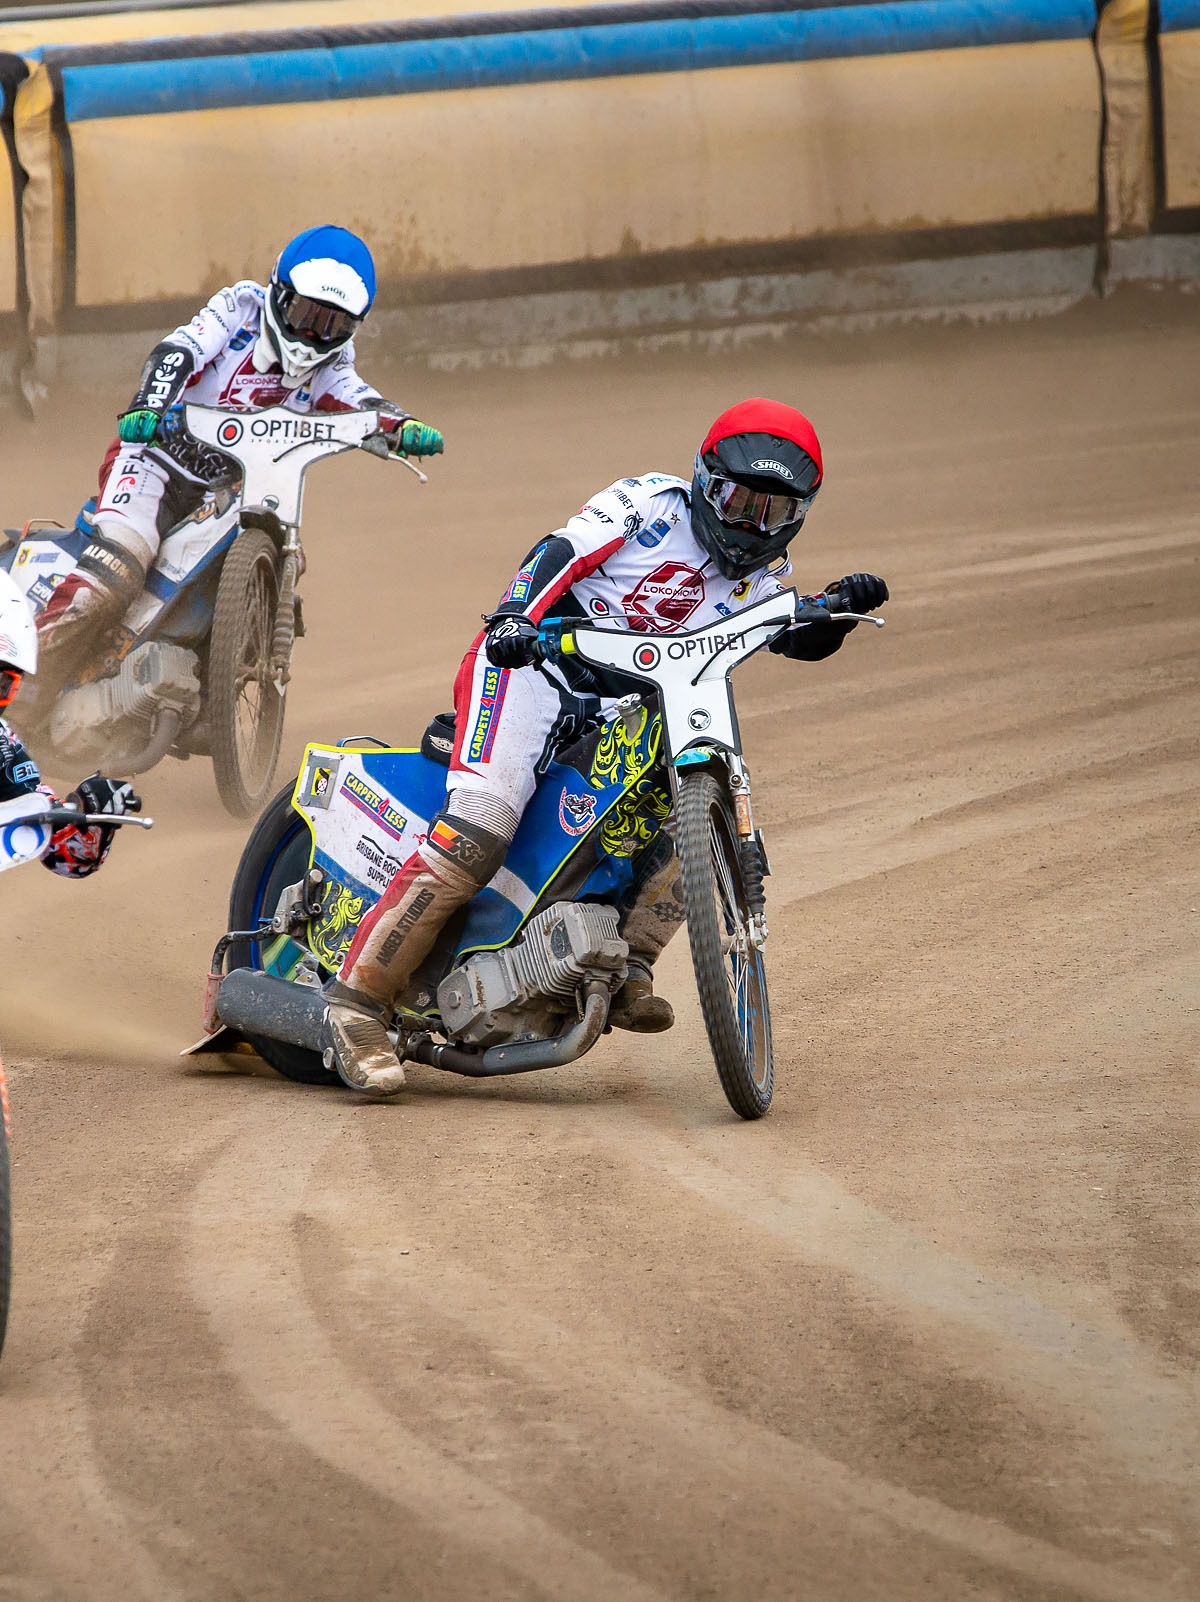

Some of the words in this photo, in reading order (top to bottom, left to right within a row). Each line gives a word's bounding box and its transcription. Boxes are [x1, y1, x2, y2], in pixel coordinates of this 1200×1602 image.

[235, 374, 282, 386] LOKOMO
[251, 419, 336, 441] OPTIBET
[757, 461, 789, 477] SHOEI
[667, 631, 747, 661] OPTIBET
[485, 671, 498, 696] LESS
[480, 696, 496, 708] 4
[470, 709, 491, 758] CARPETS
[346, 774, 380, 808] CARPETS
[378, 798, 390, 816] 4
[383, 807, 406, 830] LESS
[356, 840, 382, 868] BRISBANE
[367, 866, 392, 889] SUPPLI
[375, 929, 406, 968] AMBER
[396, 888, 436, 933] STUDIOS
